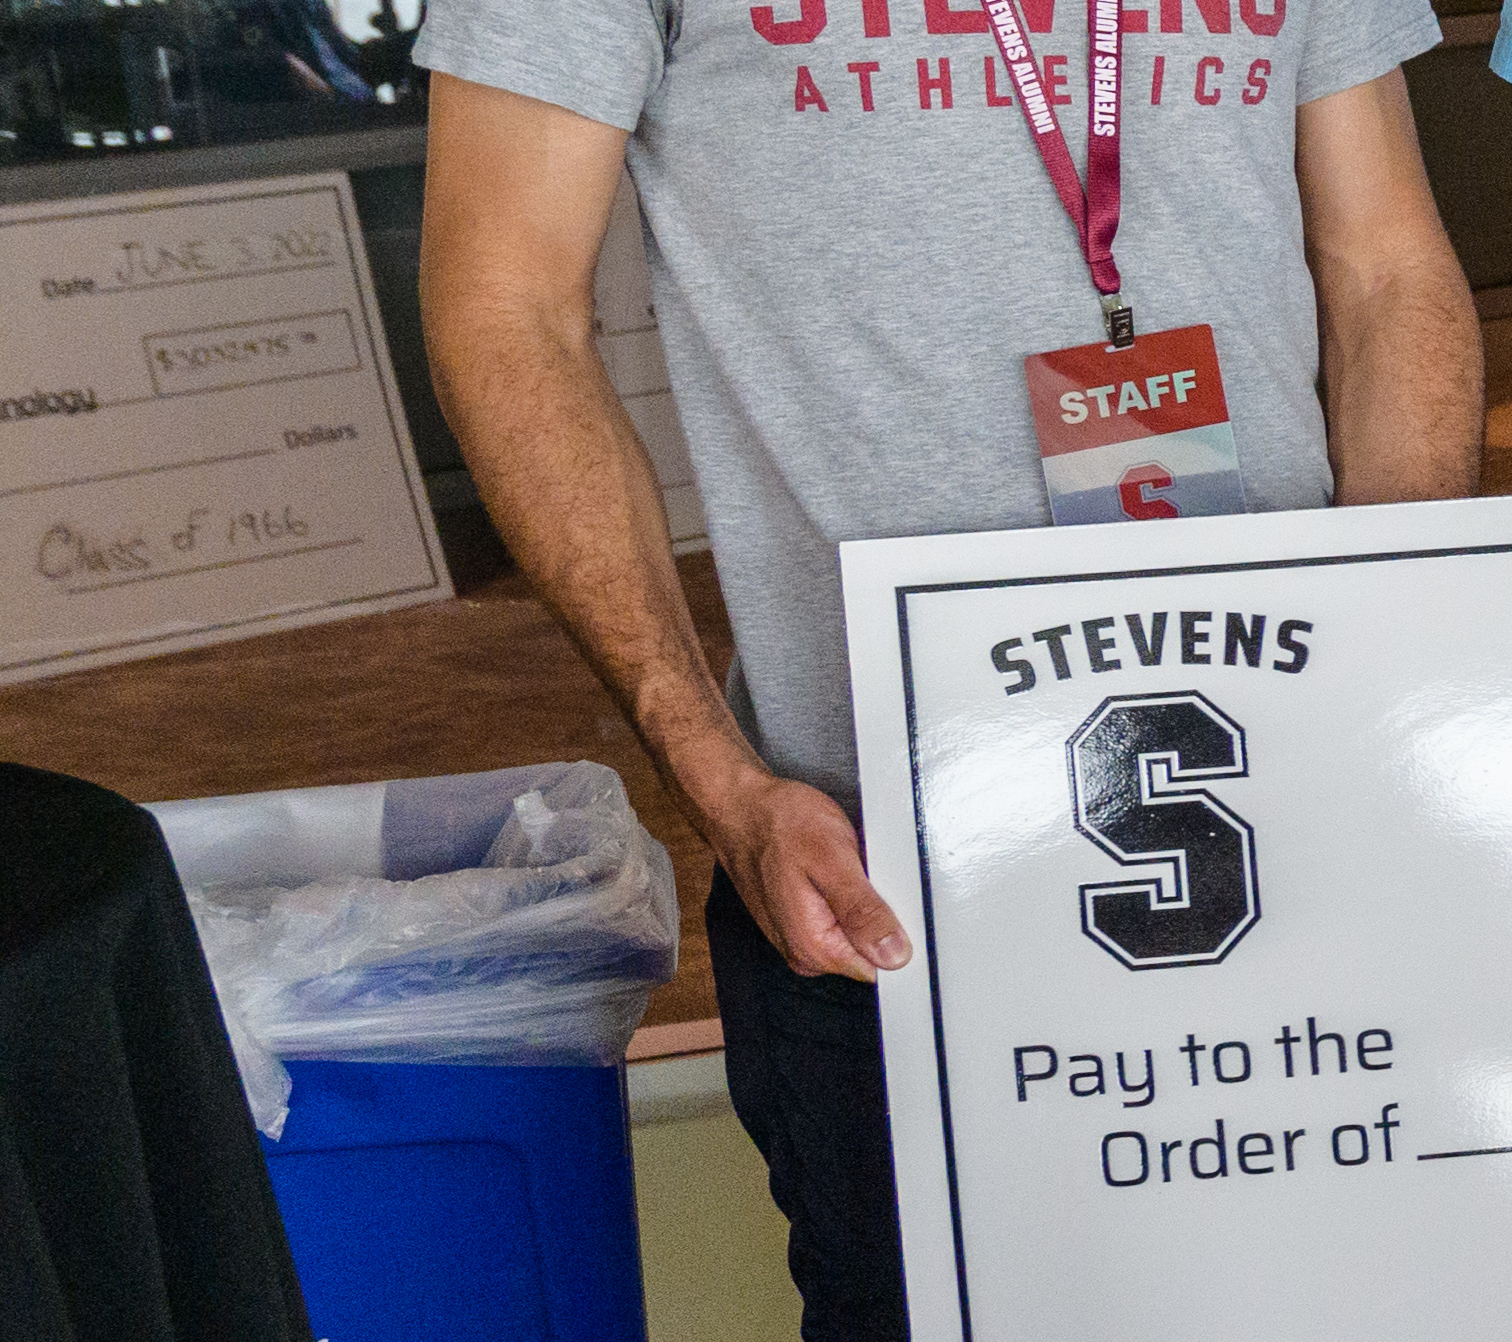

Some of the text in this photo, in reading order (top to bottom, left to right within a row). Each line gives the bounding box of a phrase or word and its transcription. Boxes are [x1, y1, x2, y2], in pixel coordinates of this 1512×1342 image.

[794, 56, 1272, 113] ATHLEICS
[1012, 62, 1056, 135] ALUMNI
[1093, 56, 1118, 137] STEVENS
[41, 276, 96, 300] Date
[1059, 369, 1198, 425] STAFF
[283, 424, 359, 451] Dollars
[36, 504, 310, 581] Class of 1966
[990, 610, 1316, 696] STEVENS
[1064, 690, 1260, 972] S
[1014, 1015, 1396, 1109] Pay to the
[1099, 1111, 1312, 1191] Order
[1330, 1102, 1401, 1167] of
